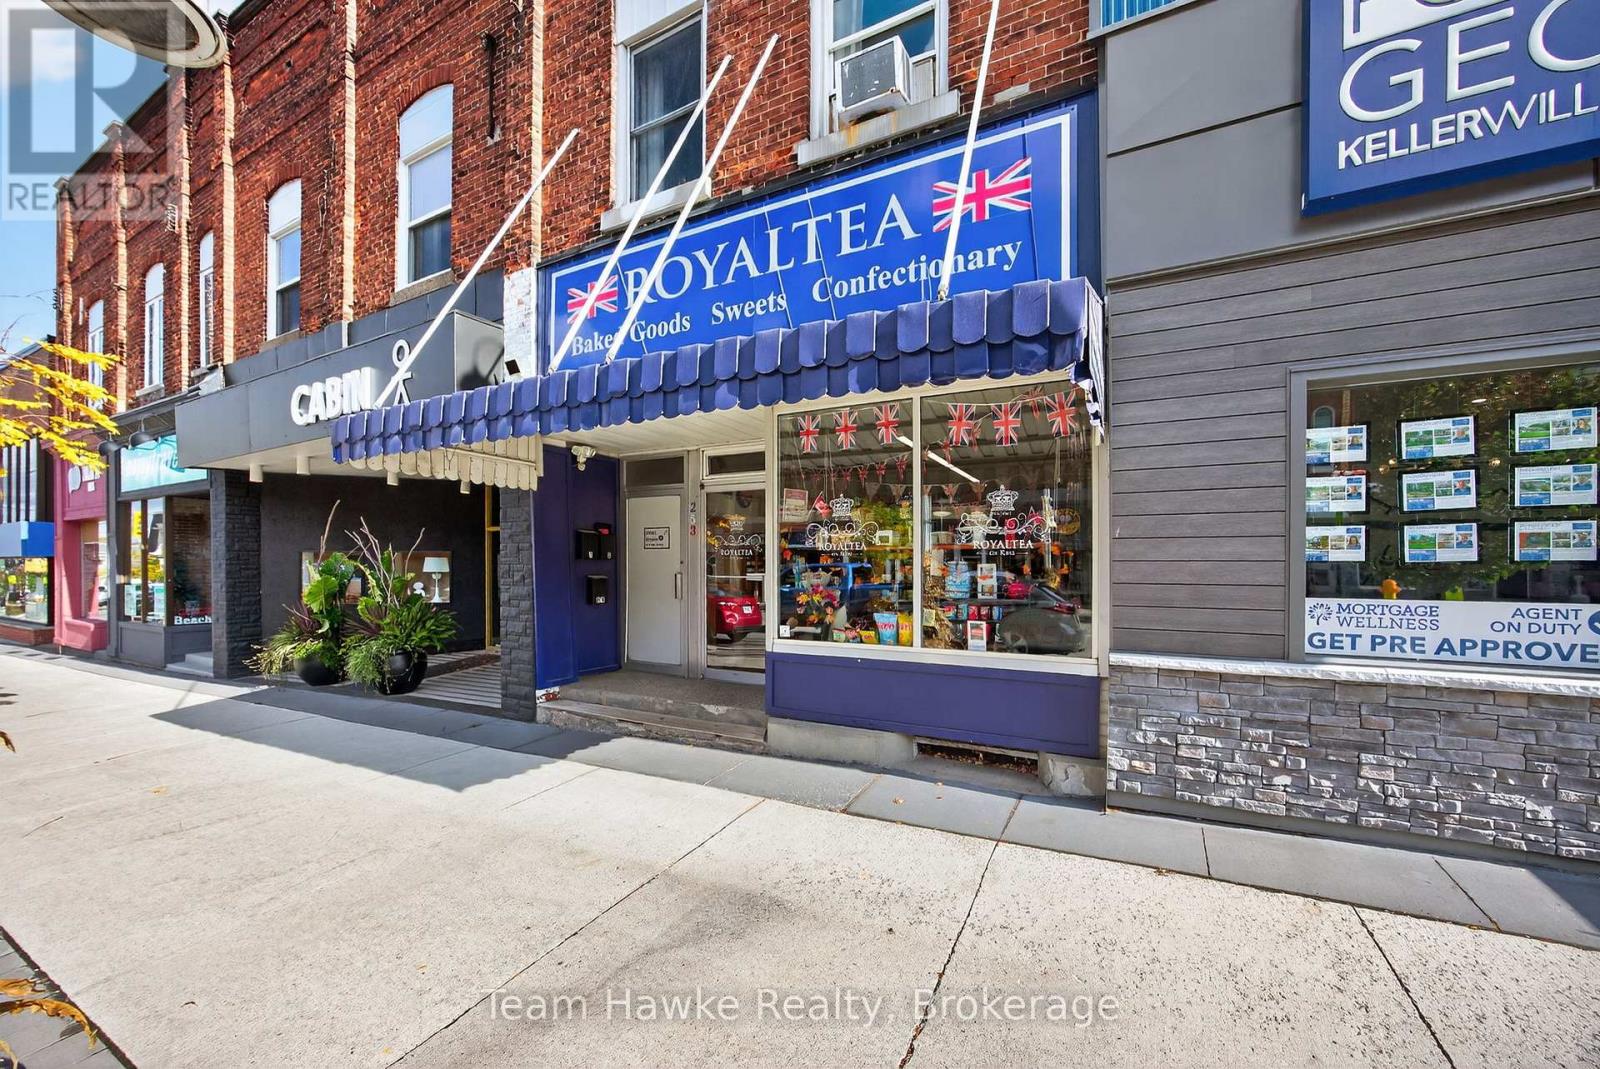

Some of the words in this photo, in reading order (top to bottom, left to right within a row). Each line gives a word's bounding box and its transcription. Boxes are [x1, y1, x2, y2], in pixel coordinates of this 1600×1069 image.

[624, 194, 922, 310] ROYALTEA
[571, 326, 625, 357] Bake
[629, 312, 691, 343] Goods
[711, 291, 787, 325] Sweets
[812, 241, 1022, 303] Confectionary
[290, 366, 376, 426] CABIN
[973, 540, 1034, 550] ROYALTEA
[1336, 603, 1440, 617] MORTGAGE
[1511, 607, 1583, 620] AGENT
[174, 615, 212, 625] Beach
[1336, 615, 1440, 631] WELLNESS
[1490, 620, 1521, 633] ON
[1528, 622, 1582, 635] DUTY
[1307, 632, 1362, 651] GET
[1370, 634, 1427, 654] PRE
[1434, 637, 1600, 664] APPROVE
